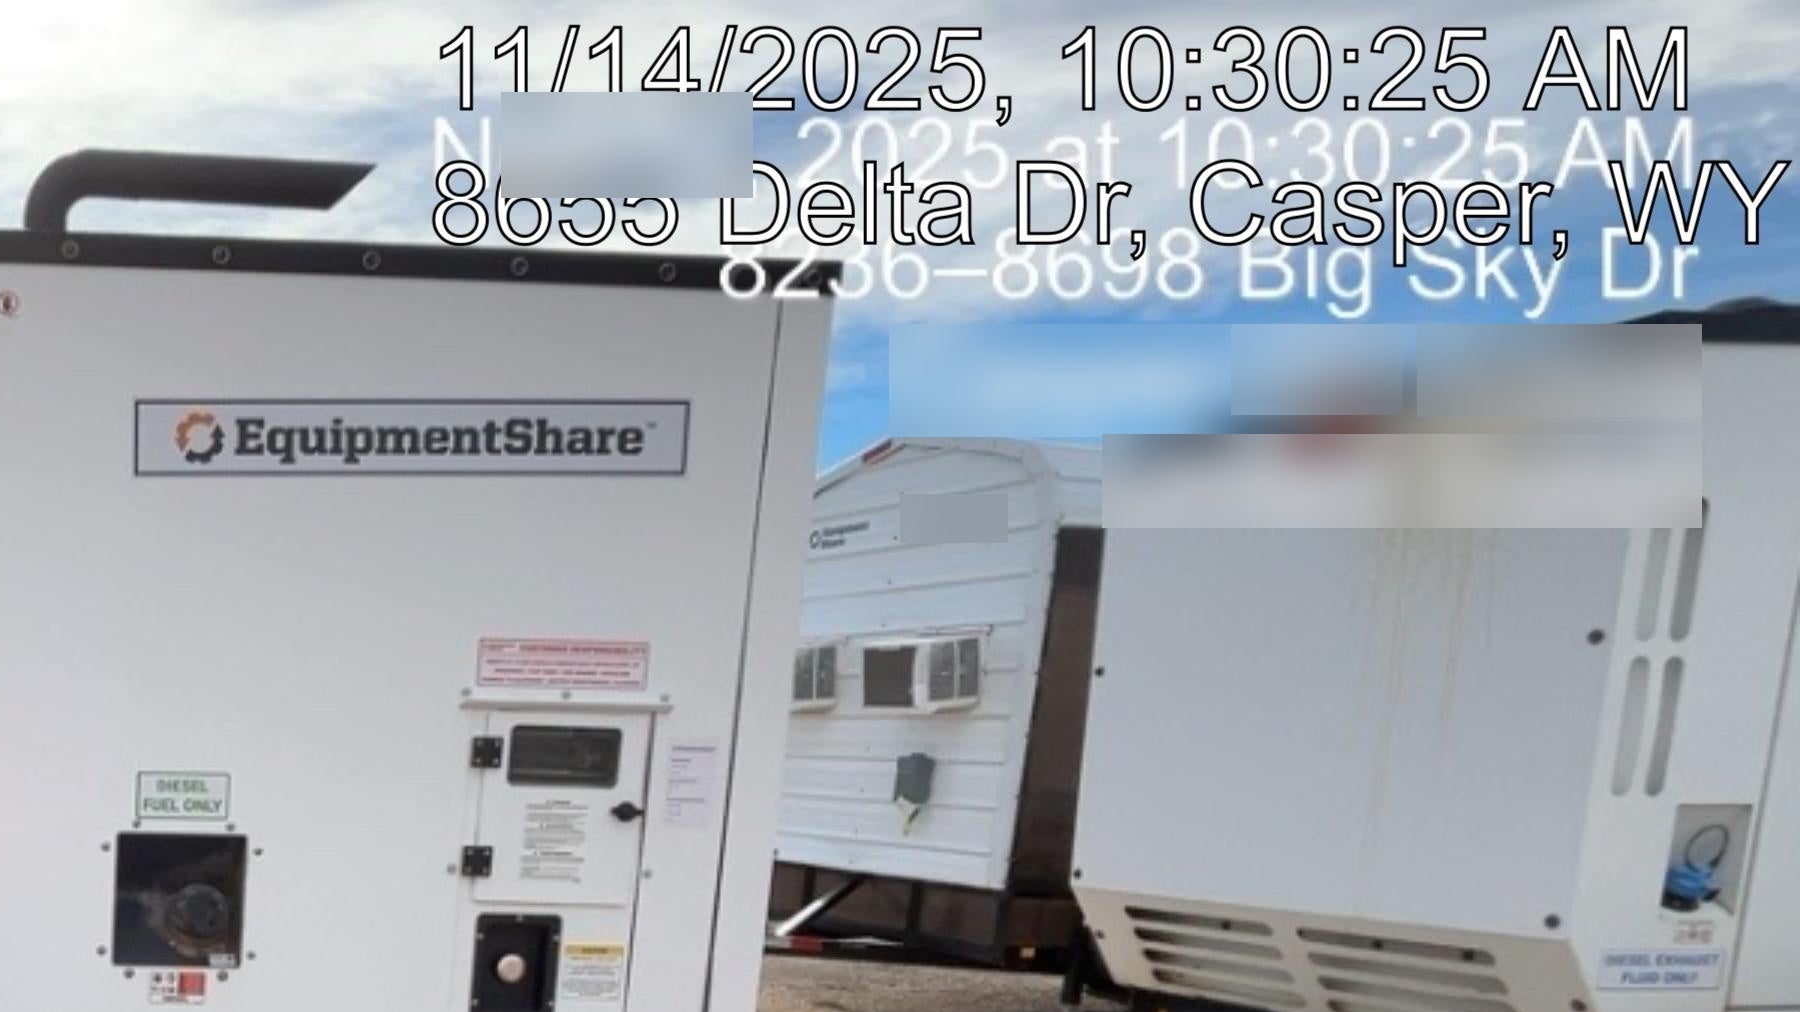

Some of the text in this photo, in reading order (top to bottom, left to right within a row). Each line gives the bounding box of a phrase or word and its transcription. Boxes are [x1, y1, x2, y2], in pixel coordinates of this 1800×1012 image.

[235, 416, 646, 465] EquipmentShare
[143, 798, 223, 813] FUEL ONLY
